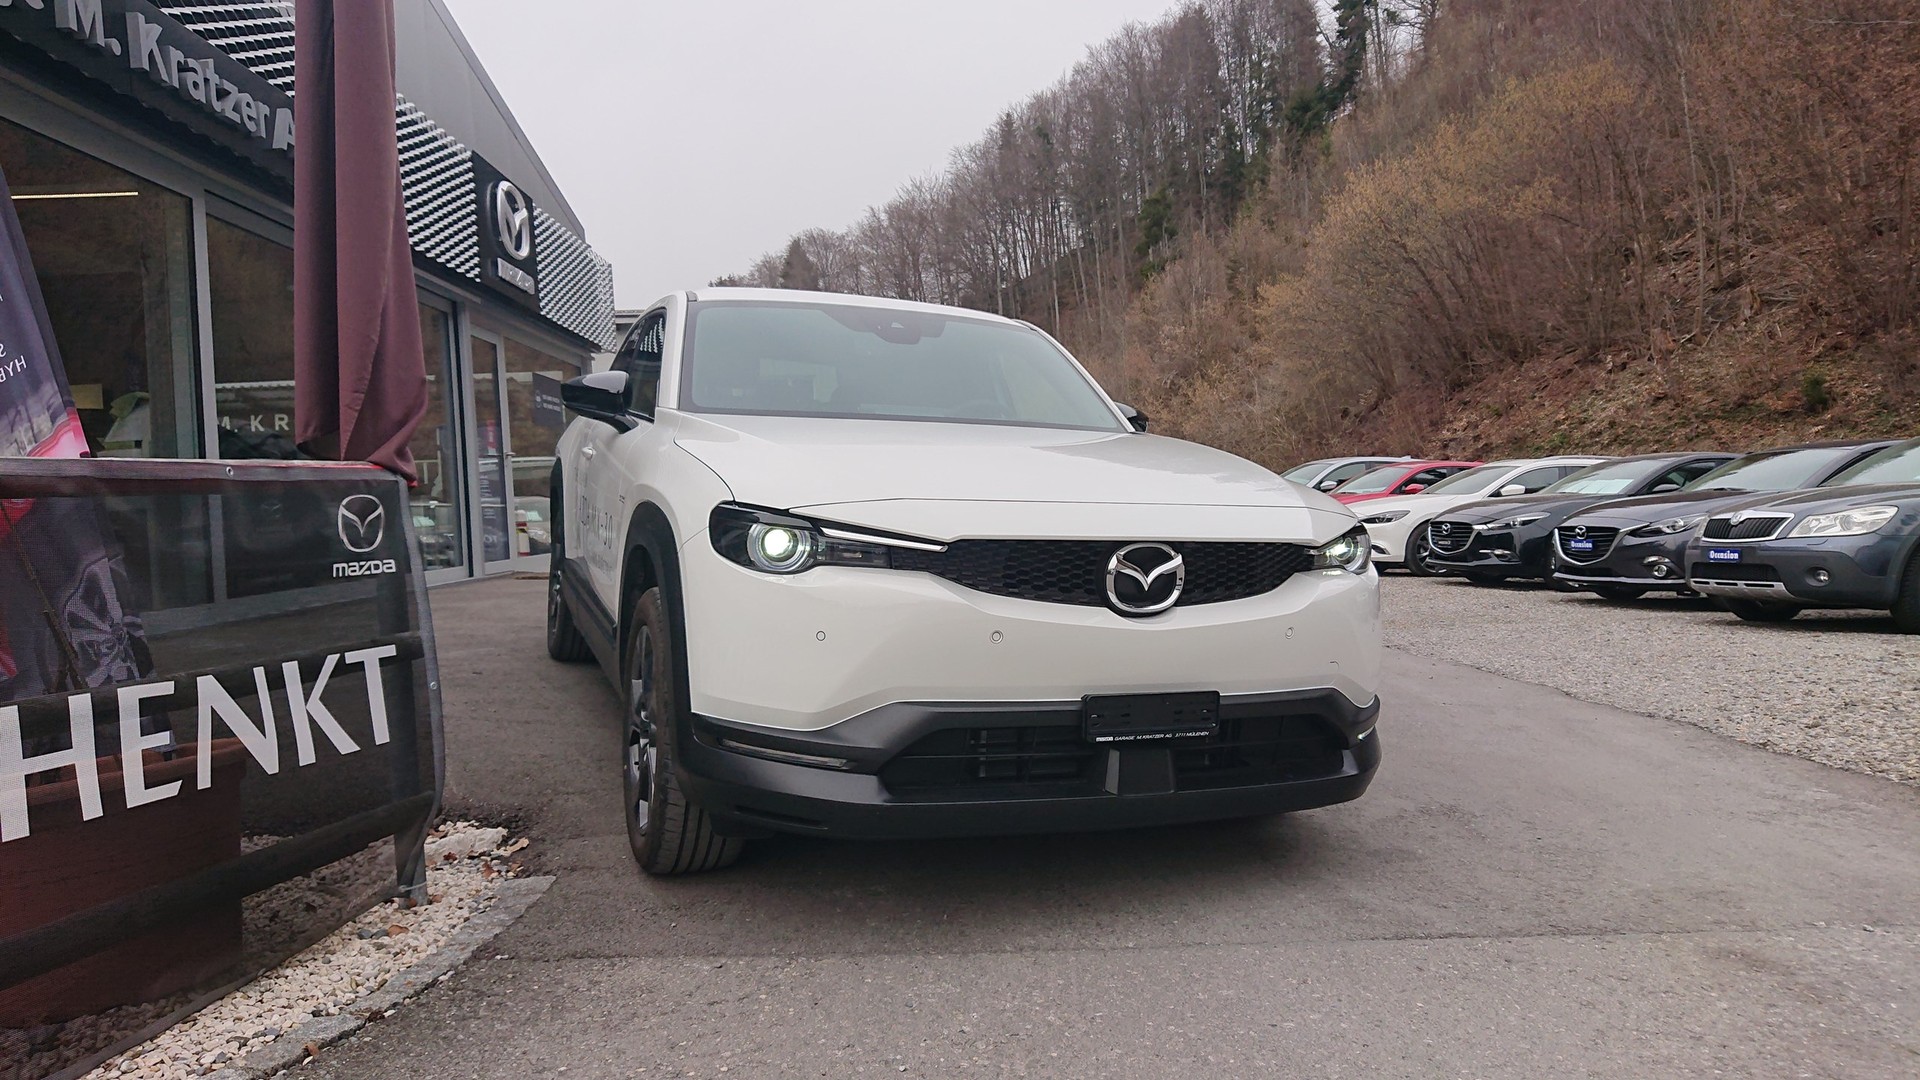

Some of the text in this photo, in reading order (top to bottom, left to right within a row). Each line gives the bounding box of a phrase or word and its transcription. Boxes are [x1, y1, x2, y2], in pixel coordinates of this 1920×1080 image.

[126, 12, 270, 139] Kratzer
[1570, 540, 1593, 549] Occasion
[1709, 550, 1739, 559] Occasion
[0, 644, 397, 843] HENKT
